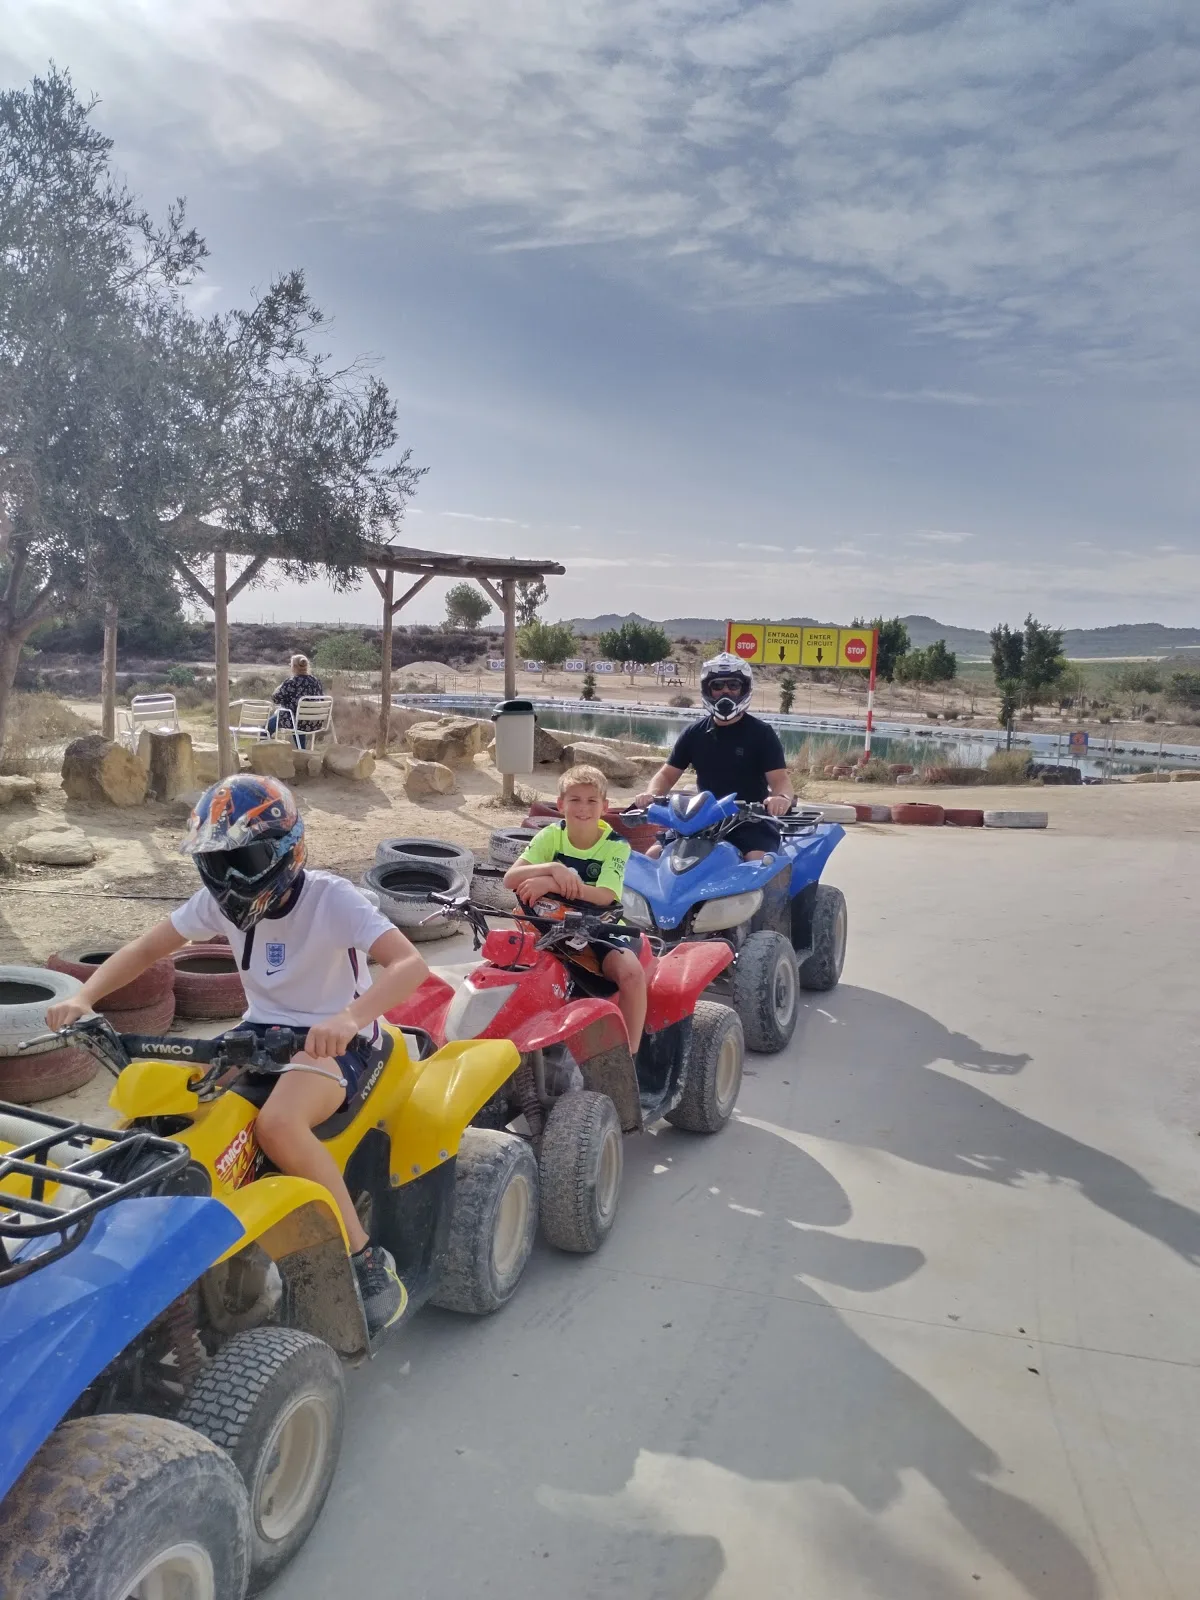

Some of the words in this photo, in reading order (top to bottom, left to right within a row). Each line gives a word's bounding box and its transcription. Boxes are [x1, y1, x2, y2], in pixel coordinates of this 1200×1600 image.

[767, 631, 799, 639] ENTRADA
[736, 641, 756, 650] STOP
[847, 646, 865, 655] STOP
[141, 1043, 194, 1055] KYMCO
[360, 1060, 384, 1100] KYMCO
